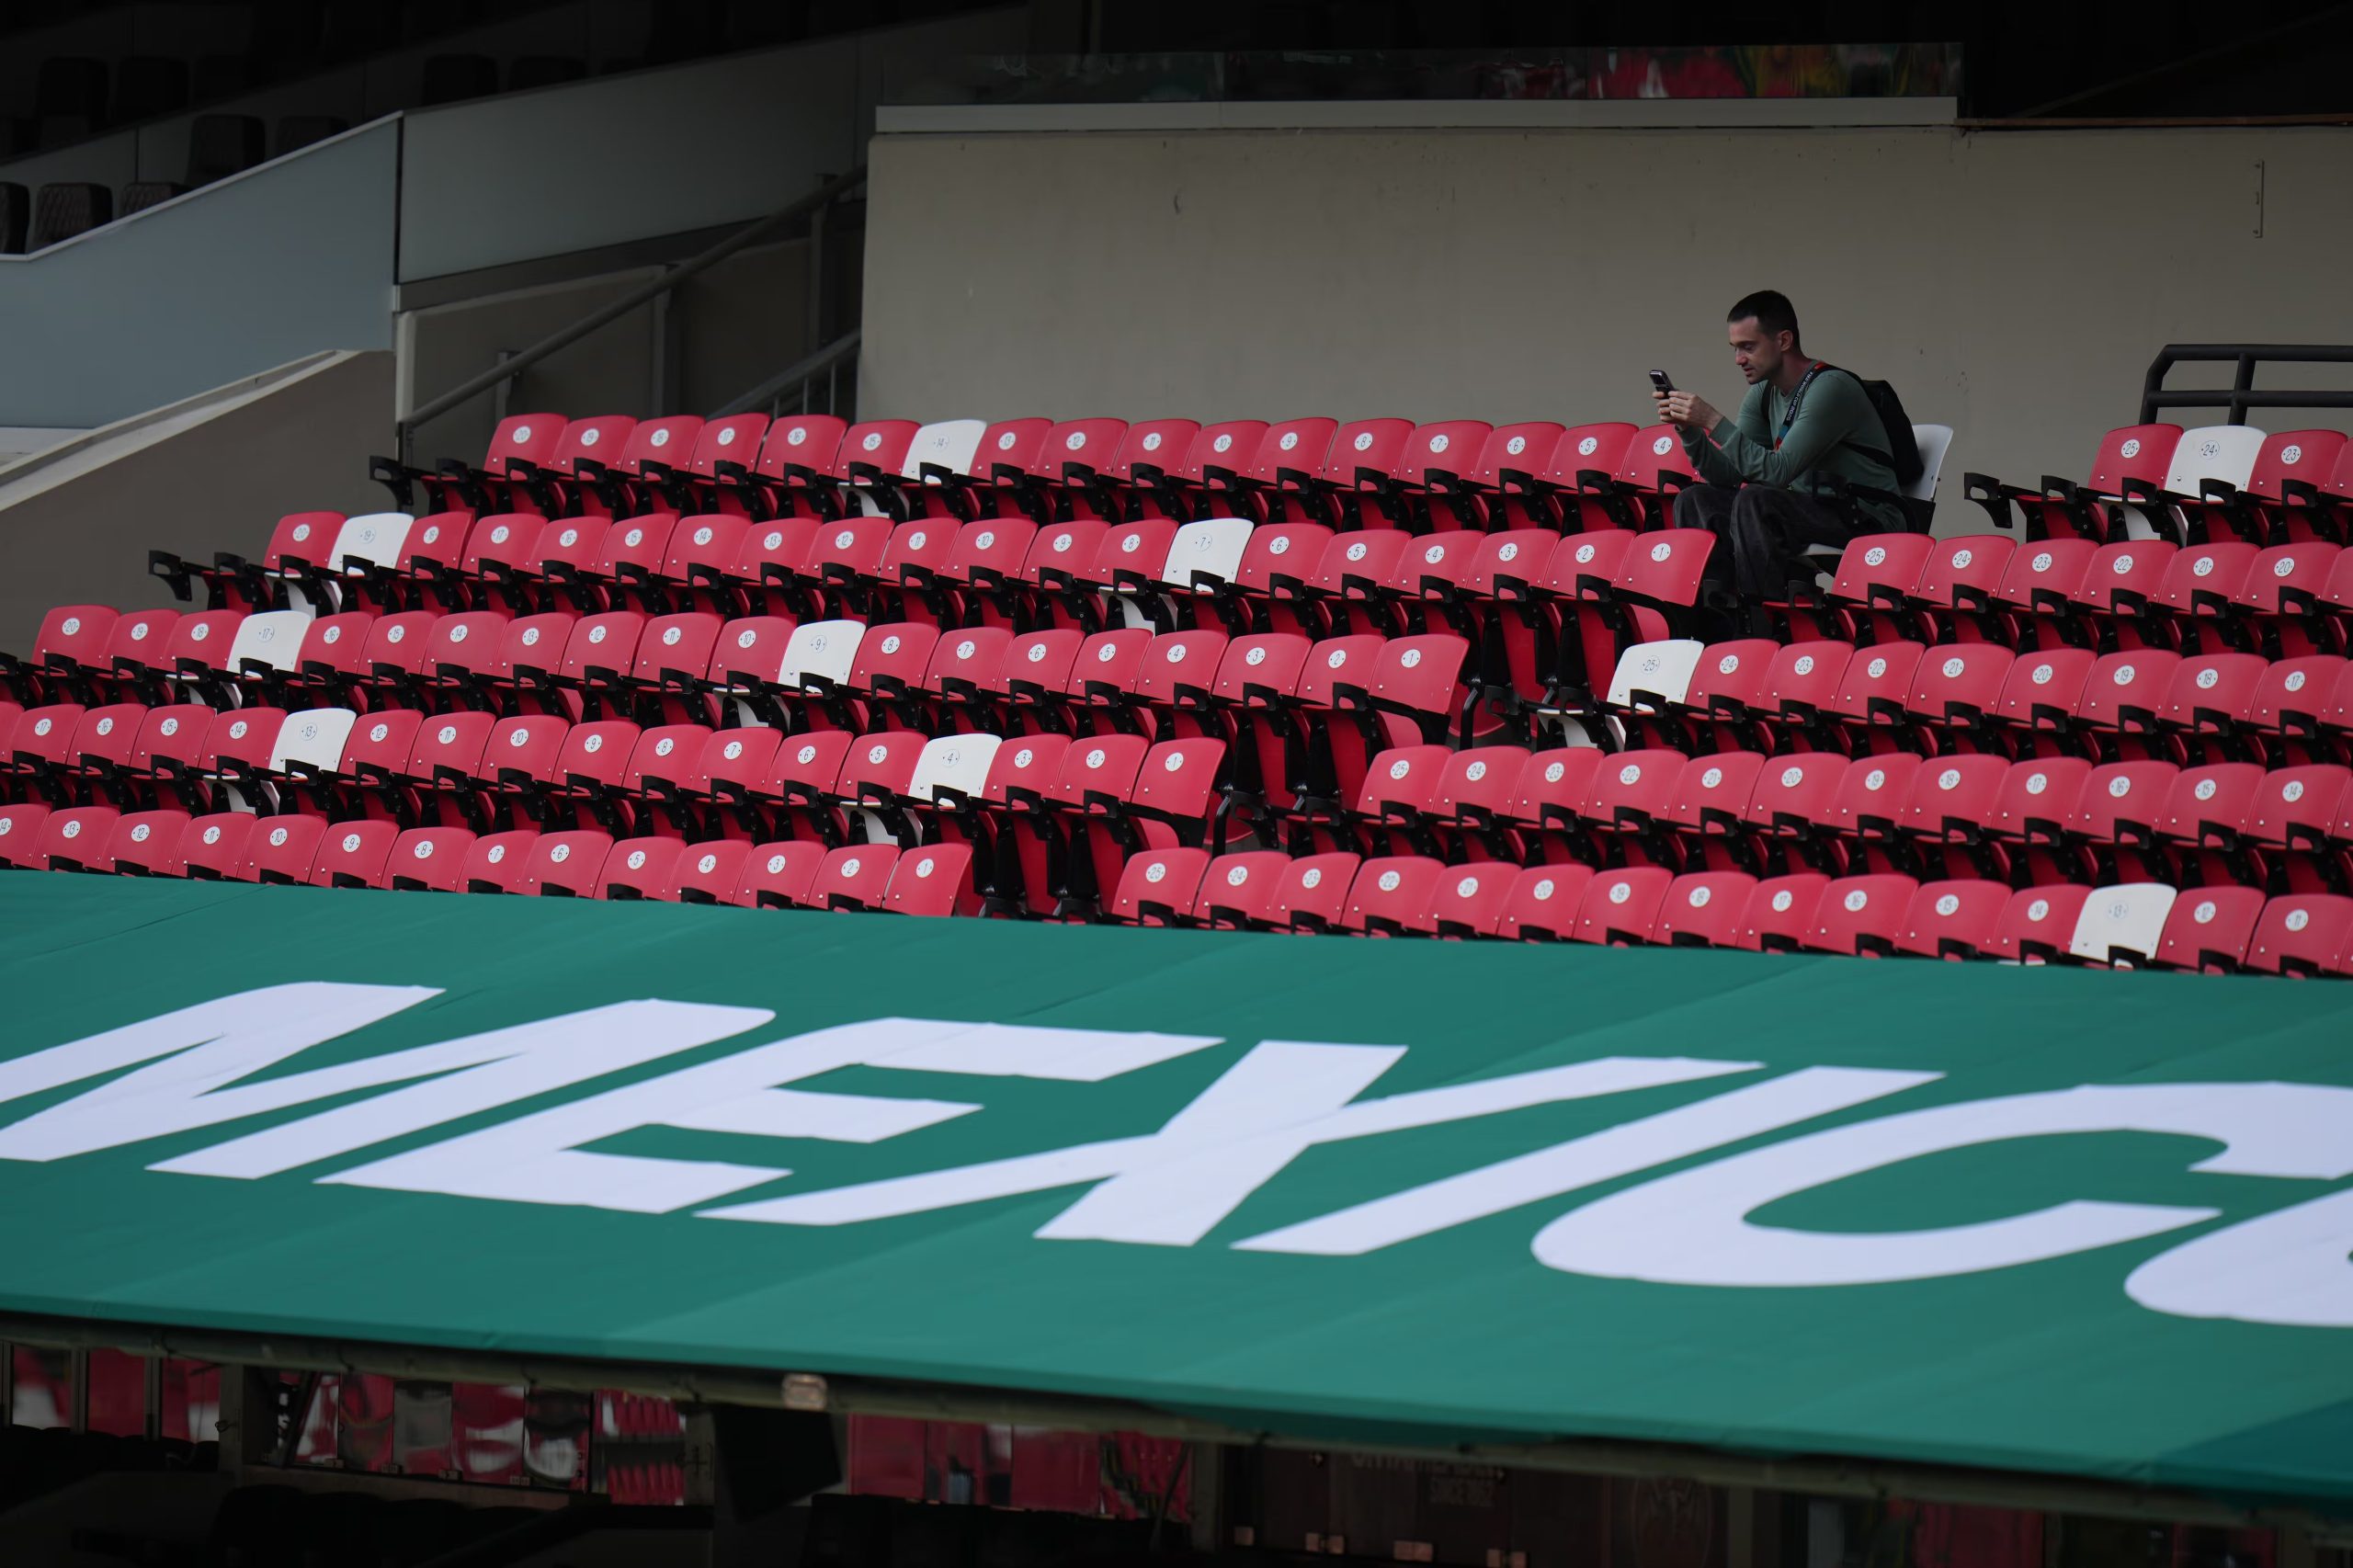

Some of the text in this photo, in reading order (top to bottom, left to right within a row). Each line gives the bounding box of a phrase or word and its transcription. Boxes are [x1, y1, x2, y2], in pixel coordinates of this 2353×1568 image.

[1219, 437, 1228, 449] 10
[2124, 442, 2136, 455] 25
[2203, 444, 2215, 456] 24
[2285, 449, 2297, 461] 23
[496, 529, 505, 541] 17
[699, 530, 708, 542] 14
[769, 535, 778, 547] 13
[841, 534, 849, 546] 12
[914, 535, 921, 547] 11
[982, 534, 991, 546] 10
[1868, 550, 1882, 563] 25
[1956, 553, 1969, 566] 24
[2036, 556, 2048, 569] 23
[2117, 558, 2129, 571] 22
[2198, 560, 2209, 573] 21
[2278, 561, 2291, 574] 20
[65, 621, 77, 632] 20
[136, 625, 144, 637] 19
[261, 628, 271, 639] 17
[328, 629, 337, 641] 16
[392, 628, 401, 640] 15
[455, 627, 464, 639] 14
[527, 630, 535, 643] 13
[593, 628, 602, 640] 12
[669, 629, 677, 642] 11
[744, 633, 753, 645] 10
[1644, 659, 1656, 671] 25
[1722, 658, 1735, 671] 24
[1798, 659, 1810, 672] 23
[1871, 662, 1883, 675] 22
[1948, 661, 1959, 674] 21
[2036, 668, 2049, 681] 20
[2120, 669, 2130, 682] 19
[2203, 672, 2213, 685] 18
[2291, 675, 2301, 688] 17
[40, 721, 47, 732] 17
[101, 721, 109, 733] 16
[166, 721, 174, 732] 15
[235, 725, 243, 736] 14
[305, 726, 313, 737] 13
[375, 727, 383, 739] 12
[444, 729, 452, 741] 11
[516, 731, 525, 743] 10
[1394, 764, 1406, 776] 25
[1470, 765, 1482, 778] 24
[1549, 763, 1561, 779] 23
[1624, 768, 1637, 782] 22
[1706, 771, 1718, 785] 21
[1786, 770, 1799, 784] 20
[1945, 770, 1955, 786] 18
[2032, 777, 2042, 790] 17
[2115, 777, 2125, 794] 16
[2201, 782, 2211, 797] 15
[2288, 784, 2298, 798] 14
[67, 824, 76, 835] 13
[136, 827, 145, 839] 12
[208, 830, 216, 841] 11
[275, 831, 283, 843] 10
[1150, 866, 1163, 879] 25
